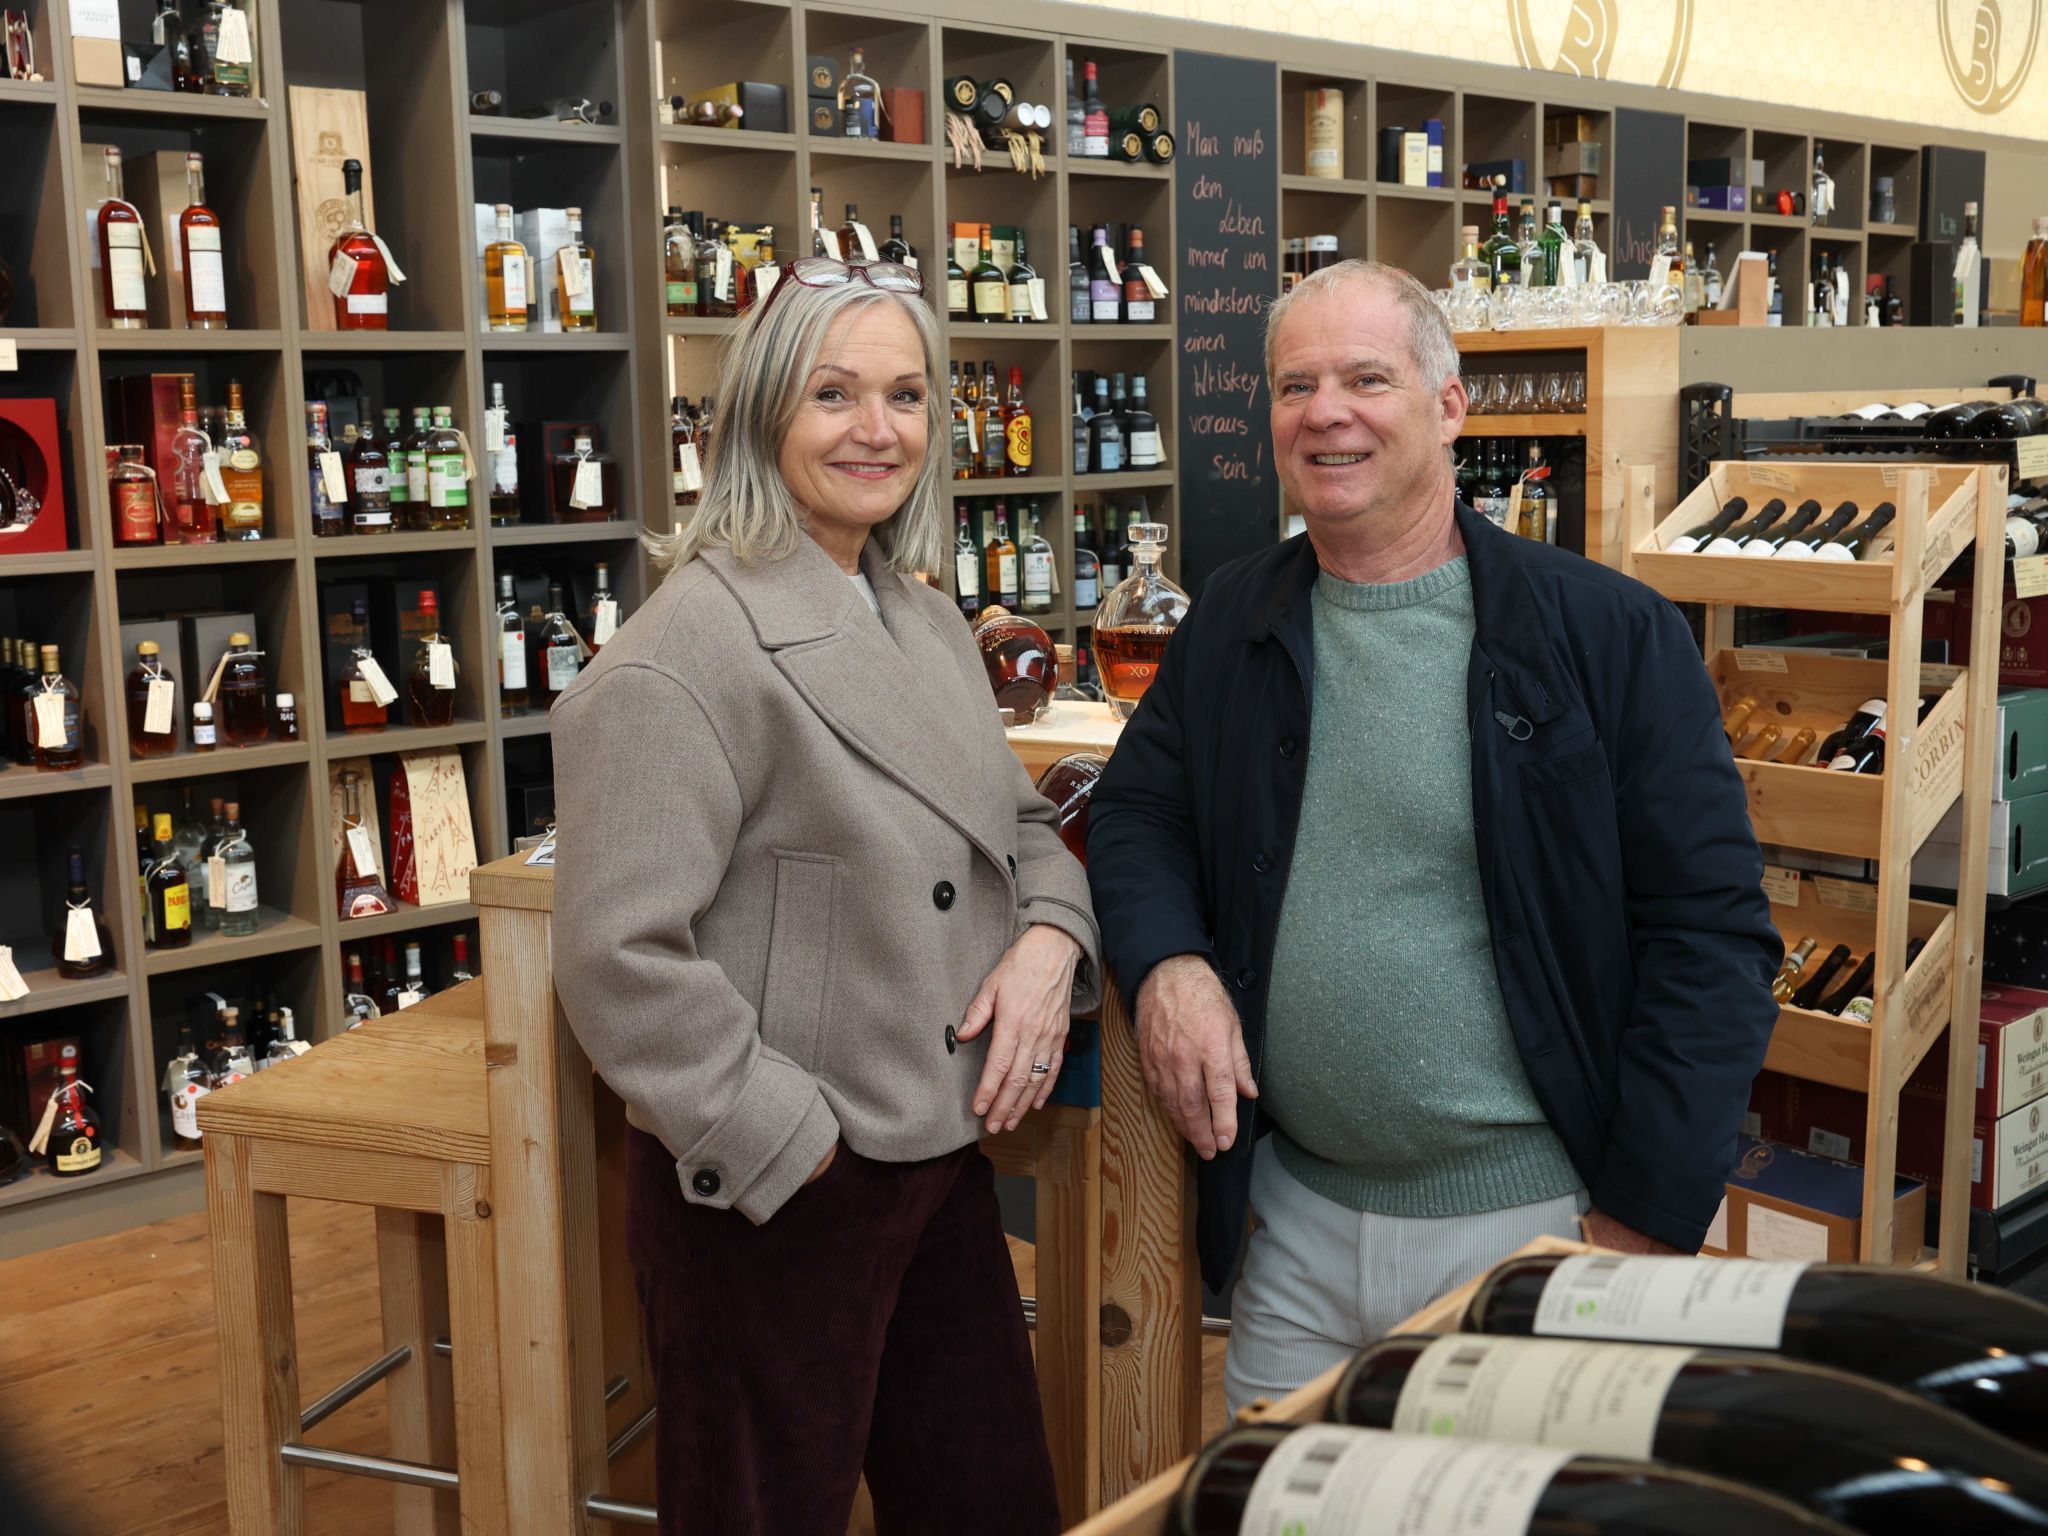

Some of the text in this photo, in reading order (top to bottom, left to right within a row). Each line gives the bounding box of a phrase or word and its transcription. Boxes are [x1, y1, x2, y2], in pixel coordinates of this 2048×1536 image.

[1187, 120, 1219, 156] Man
[1193, 174, 1222, 199] dem
[1219, 197, 1265, 236] Leben
[1188, 239, 1267, 271] immer um
[1184, 287, 1262, 315] mindestens
[1184, 328, 1226, 352] einen
[1189, 414, 1249, 436] voraus
[1129, 665, 1150, 679] XO
[2013, 1136, 2038, 1156] Weingut
